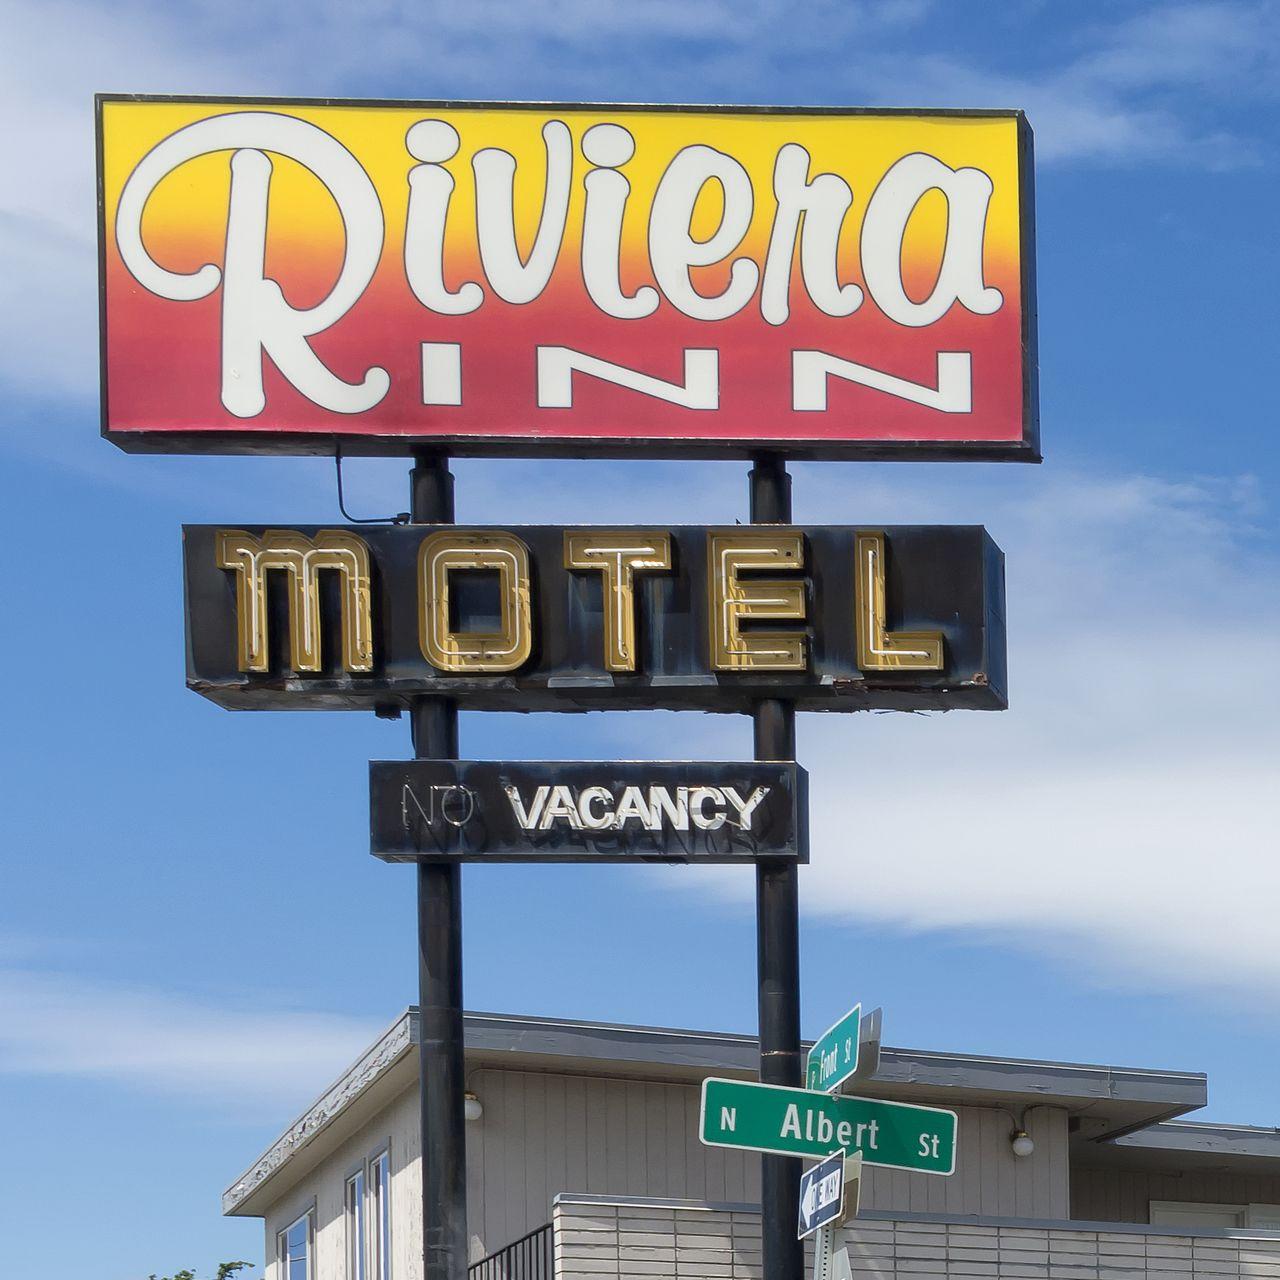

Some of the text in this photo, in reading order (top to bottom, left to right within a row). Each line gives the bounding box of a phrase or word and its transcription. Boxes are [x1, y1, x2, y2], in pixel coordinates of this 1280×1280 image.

[115, 111, 1004, 418] Riviera
[420, 341, 972, 414] INN
[215, 529, 944, 673] MOTEL
[402, 784, 771, 831] NO VACANCY
[820, 1043, 838, 1084] Front
[845, 1037, 852, 1064] St
[720, 1103, 940, 1159] N Albert St
[824, 1173, 839, 1201] WAY
